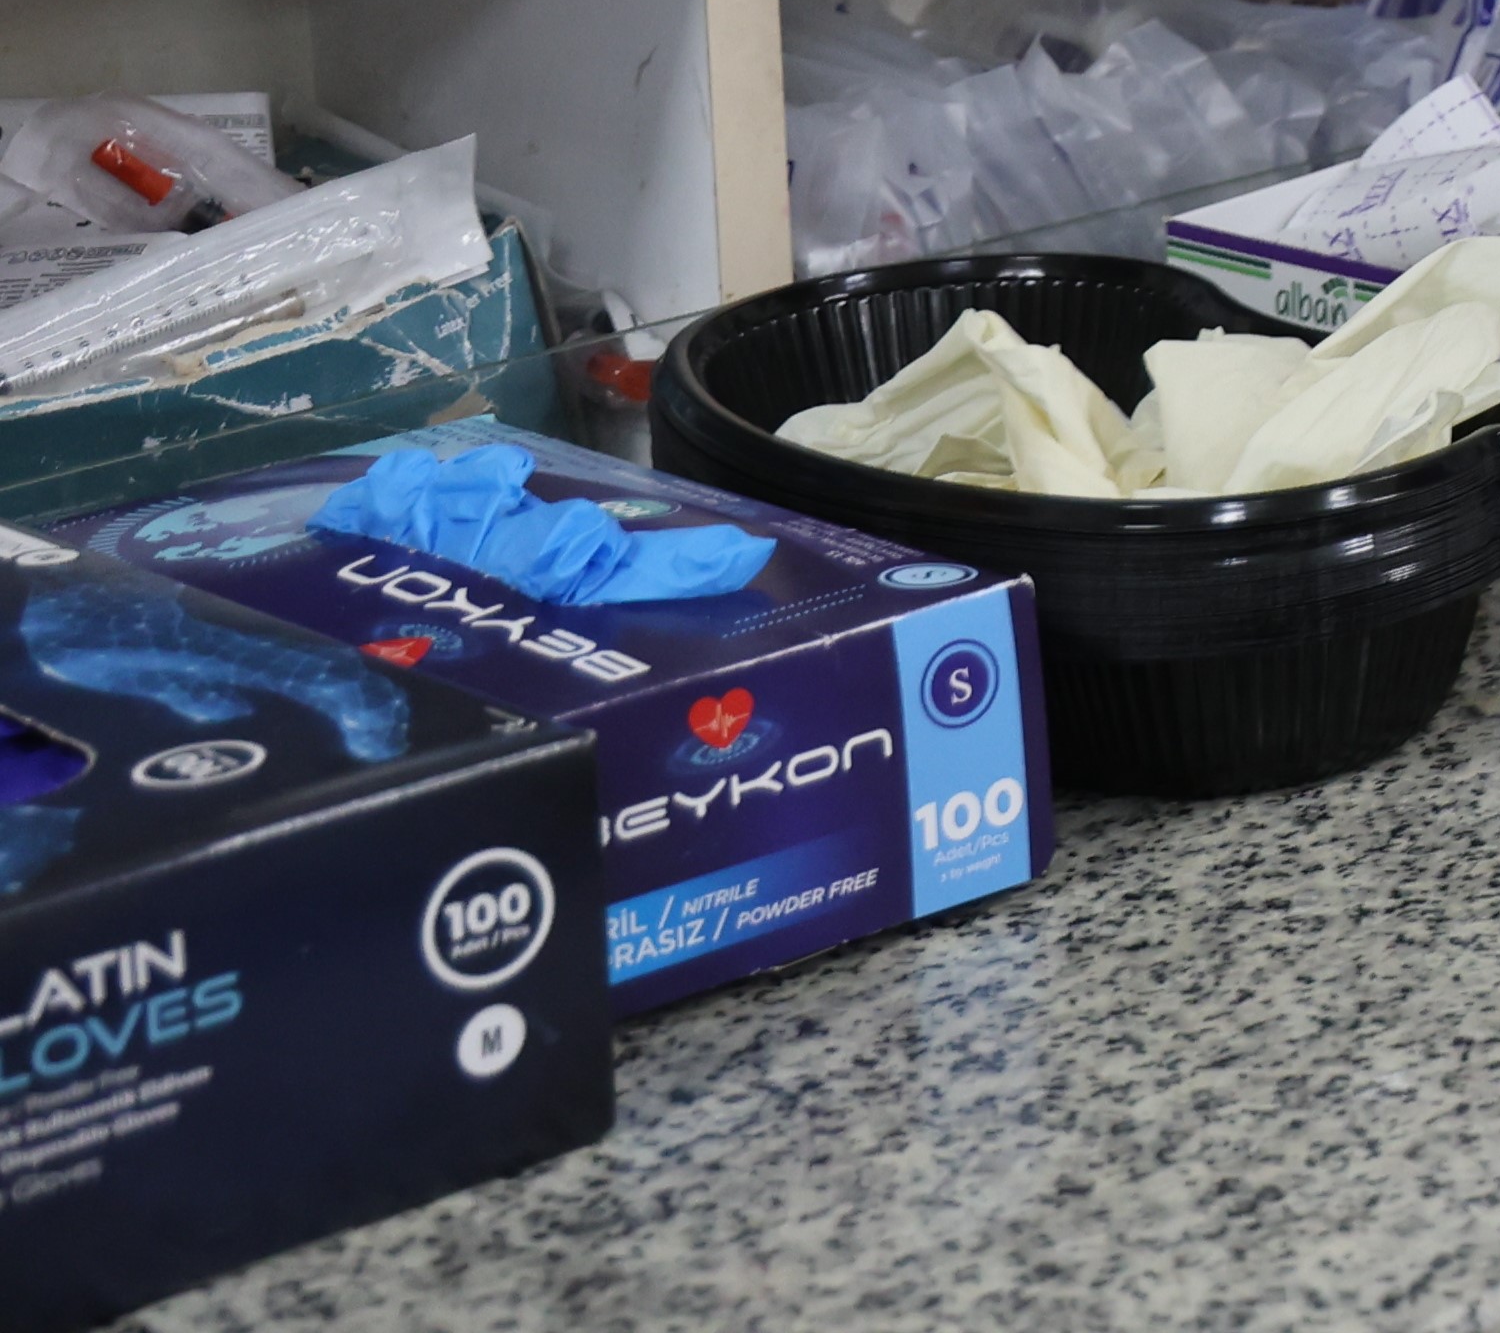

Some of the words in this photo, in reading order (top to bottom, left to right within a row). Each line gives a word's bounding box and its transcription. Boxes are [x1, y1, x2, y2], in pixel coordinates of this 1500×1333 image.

[949, 666, 973, 706] S
[914, 777, 1025, 852] 100
[444, 882, 532, 942] 100
[608, 919, 707, 970] RASIZ
[736, 886, 826, 930] POWDER
[828, 867, 881, 901] FREE
[681, 877, 761, 918] NITRILE
[480, 1023, 504, 1060] M
